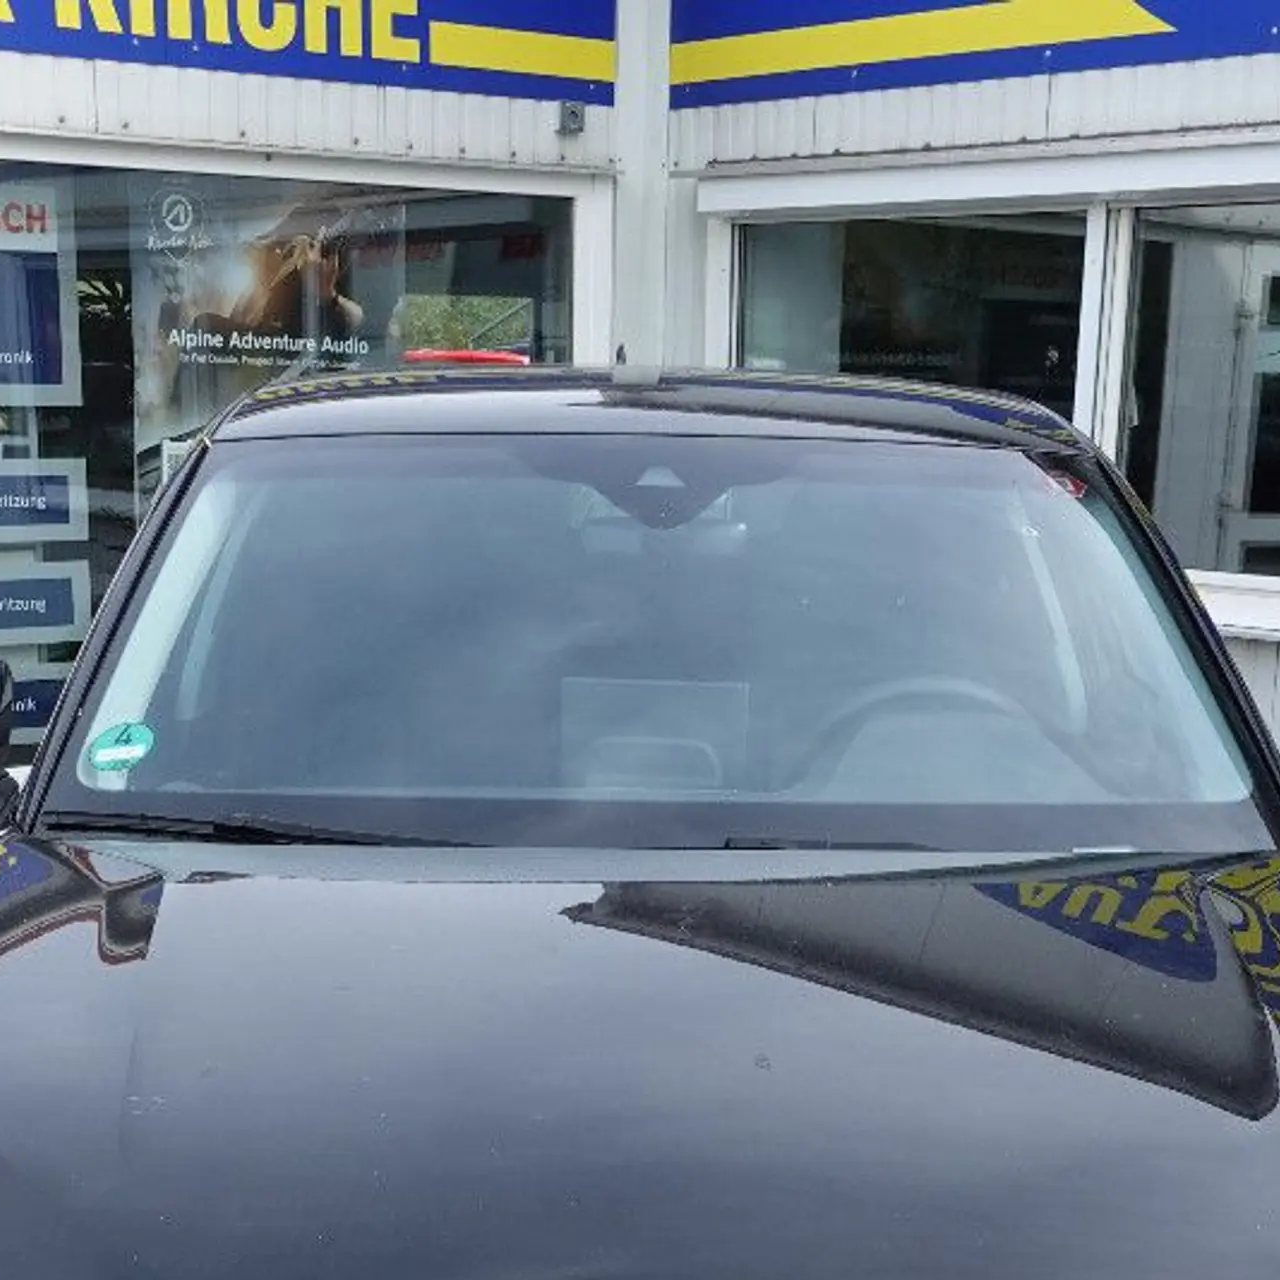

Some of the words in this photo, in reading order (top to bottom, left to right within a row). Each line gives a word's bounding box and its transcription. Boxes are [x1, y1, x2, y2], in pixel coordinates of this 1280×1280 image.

[168, 328, 224, 352] Alpine
[229, 331, 316, 352] Adventure
[321, 337, 370, 354] Audio
[114, 723, 132, 744] 4
